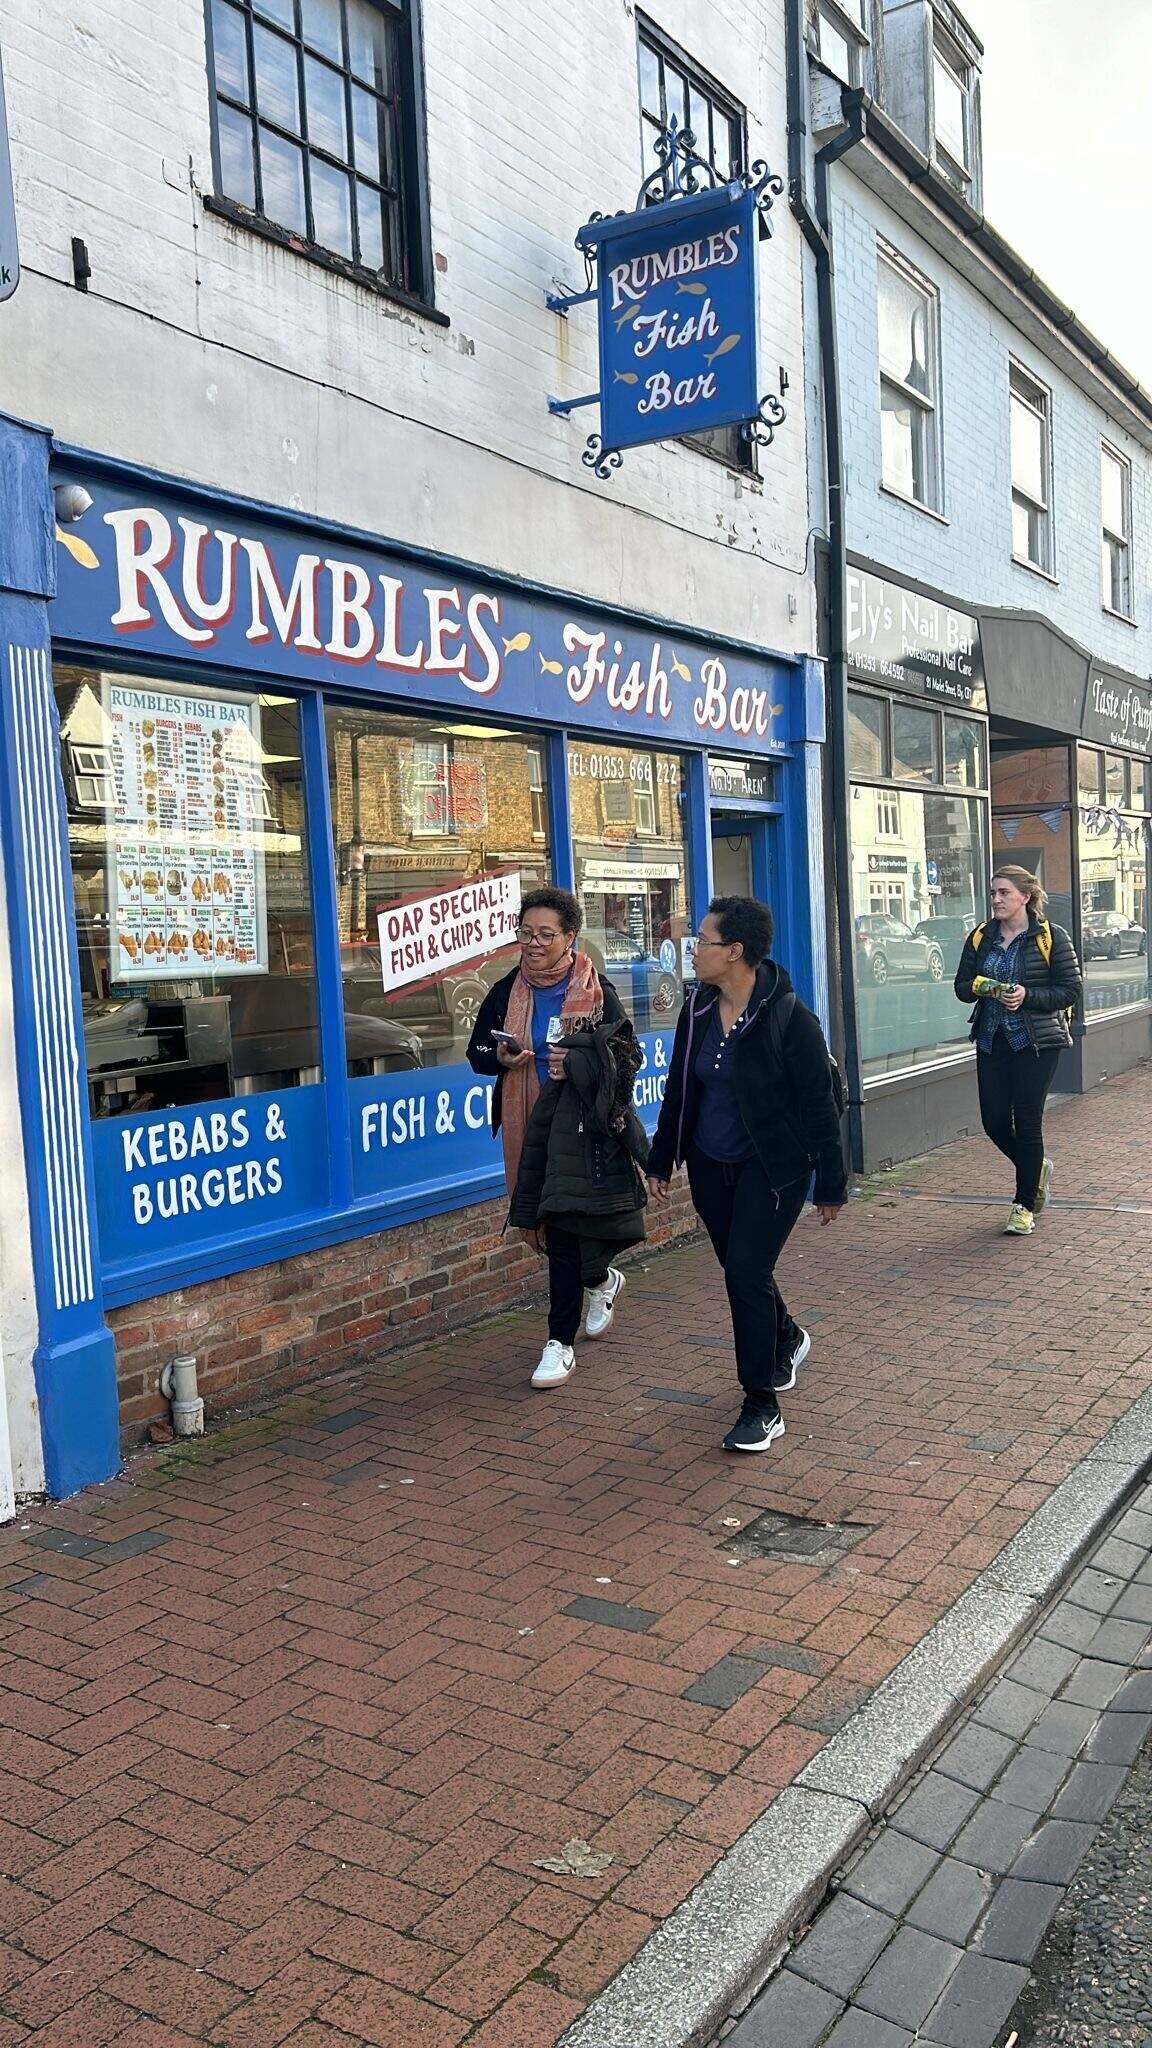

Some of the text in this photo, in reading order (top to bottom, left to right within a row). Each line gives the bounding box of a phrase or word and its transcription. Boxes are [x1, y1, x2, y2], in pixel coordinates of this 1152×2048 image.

[608, 224, 742, 311] RUMBLES
[632, 297, 720, 358] Fish
[637, 370, 717, 415] Bar
[102, 507, 769, 737] RUMBLES Fish Bar
[847, 574, 976, 657] Ely's Nail Bar
[855, 651, 877, 673] 01353
[880, 660, 905, 681] 664592
[901, 634, 973, 677] Professional Nail Care
[111, 689, 247, 726] RUMBLES FISH BAR
[1092, 677, 1119, 719] Taste
[1120, 688, 1133, 734] of
[629, 759, 651, 783] 666
[656, 761, 679, 785] 222
[388, 907, 424, 942] OAP
[391, 940, 426, 974] FISH
[427, 933, 440, 960] &
[441, 919, 483, 954] CHIPS
[654, 1037, 667, 1068] &
[632, 1073, 669, 1107] CHIC
[121, 1103, 287, 1173] KEBABS &
[361, 1095, 426, 1153] FISH
[435, 1090, 456, 1135] &
[132, 1157, 283, 1225] BURGERS
